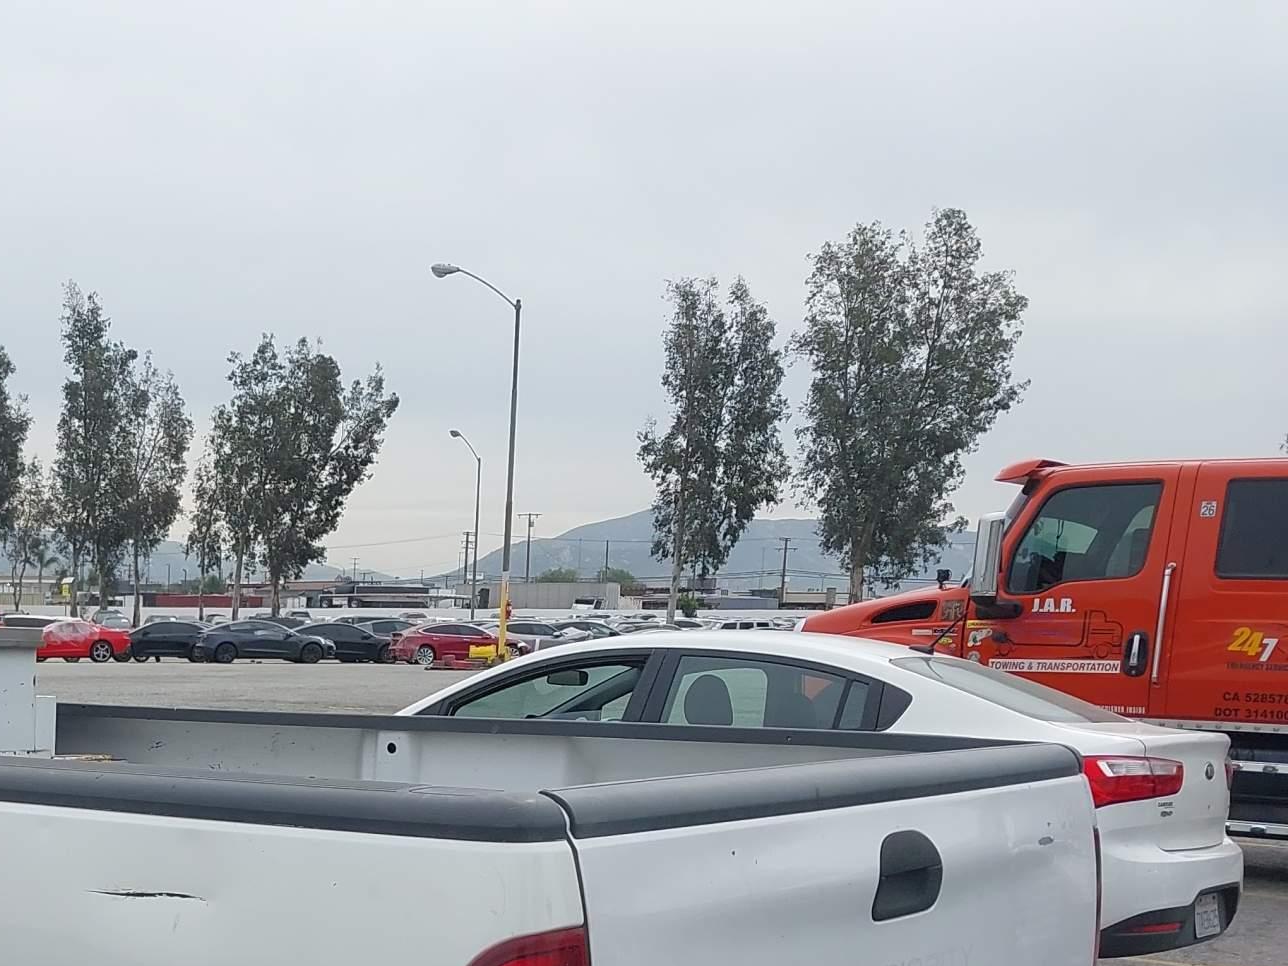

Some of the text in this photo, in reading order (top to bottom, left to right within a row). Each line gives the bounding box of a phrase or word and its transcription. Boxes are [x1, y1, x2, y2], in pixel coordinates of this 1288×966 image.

[1201, 505, 1215, 516] 26
[1031, 598, 1077, 613] J.A.R.
[990, 660, 1119, 672] TOWING & TRANSPORTATION
[1223, 692, 1240, 702] CA
[1214, 707, 1240, 717] DOT
